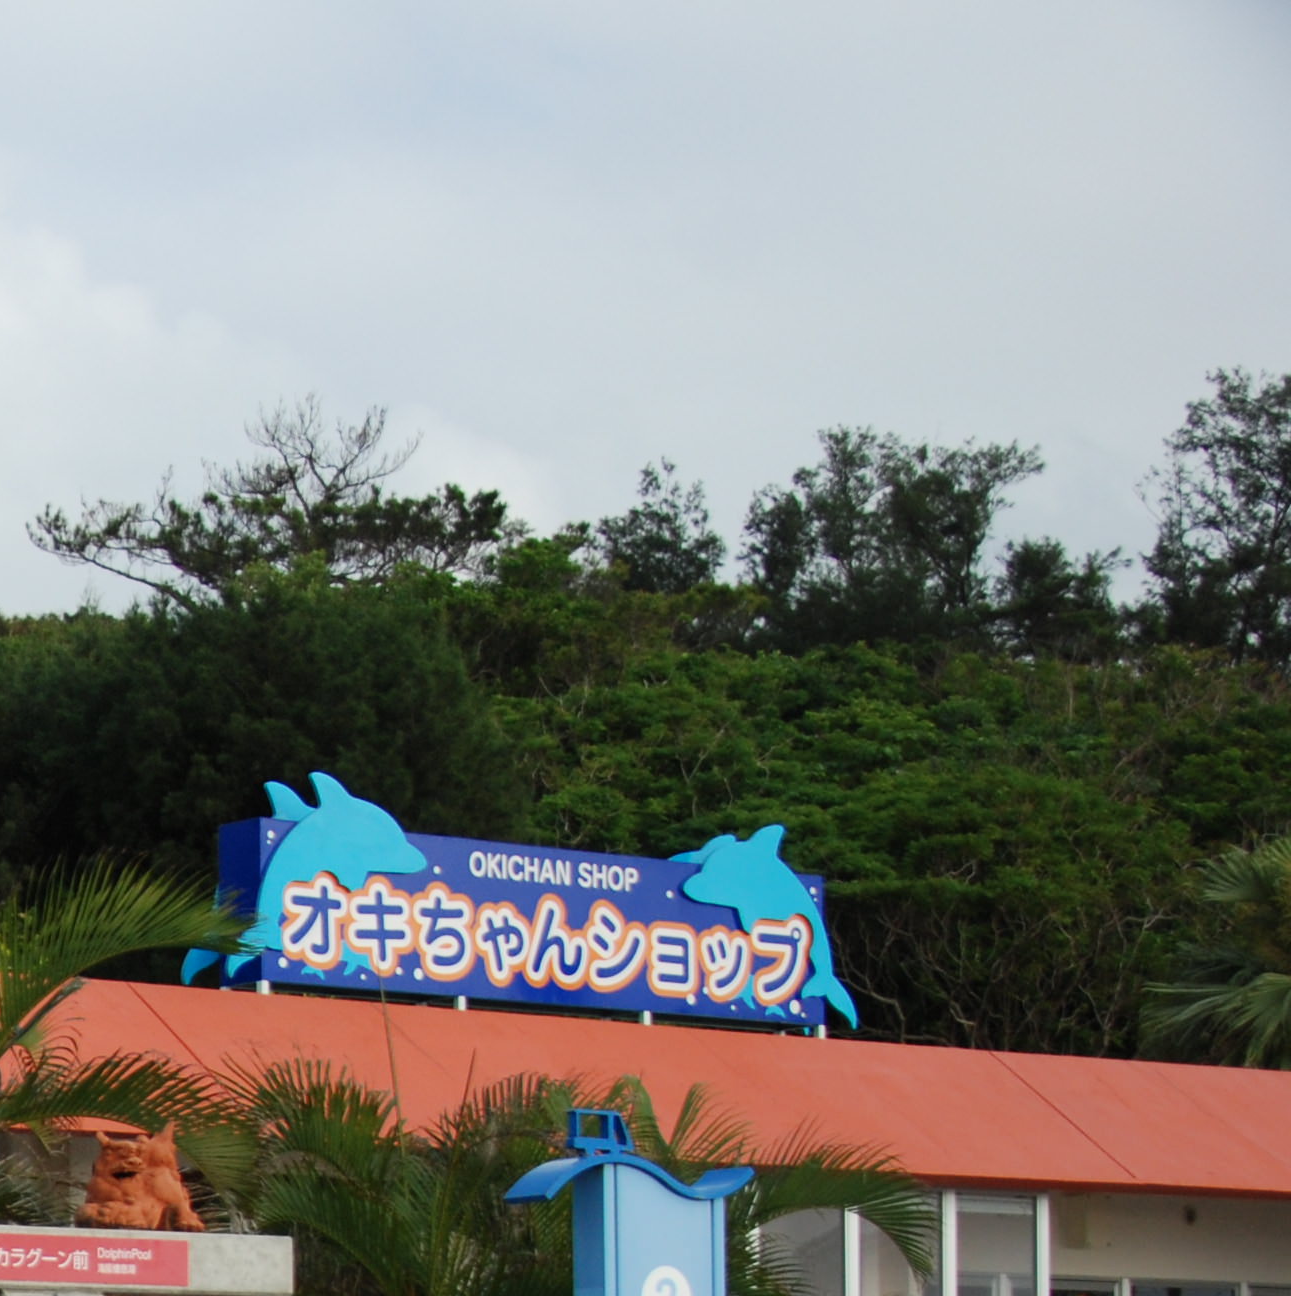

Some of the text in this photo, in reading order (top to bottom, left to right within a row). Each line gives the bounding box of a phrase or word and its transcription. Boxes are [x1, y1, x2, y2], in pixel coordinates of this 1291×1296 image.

[470, 851, 639, 892] OKICHAN SHOP
[285, 876, 808, 1001] オキちゃんショップ
